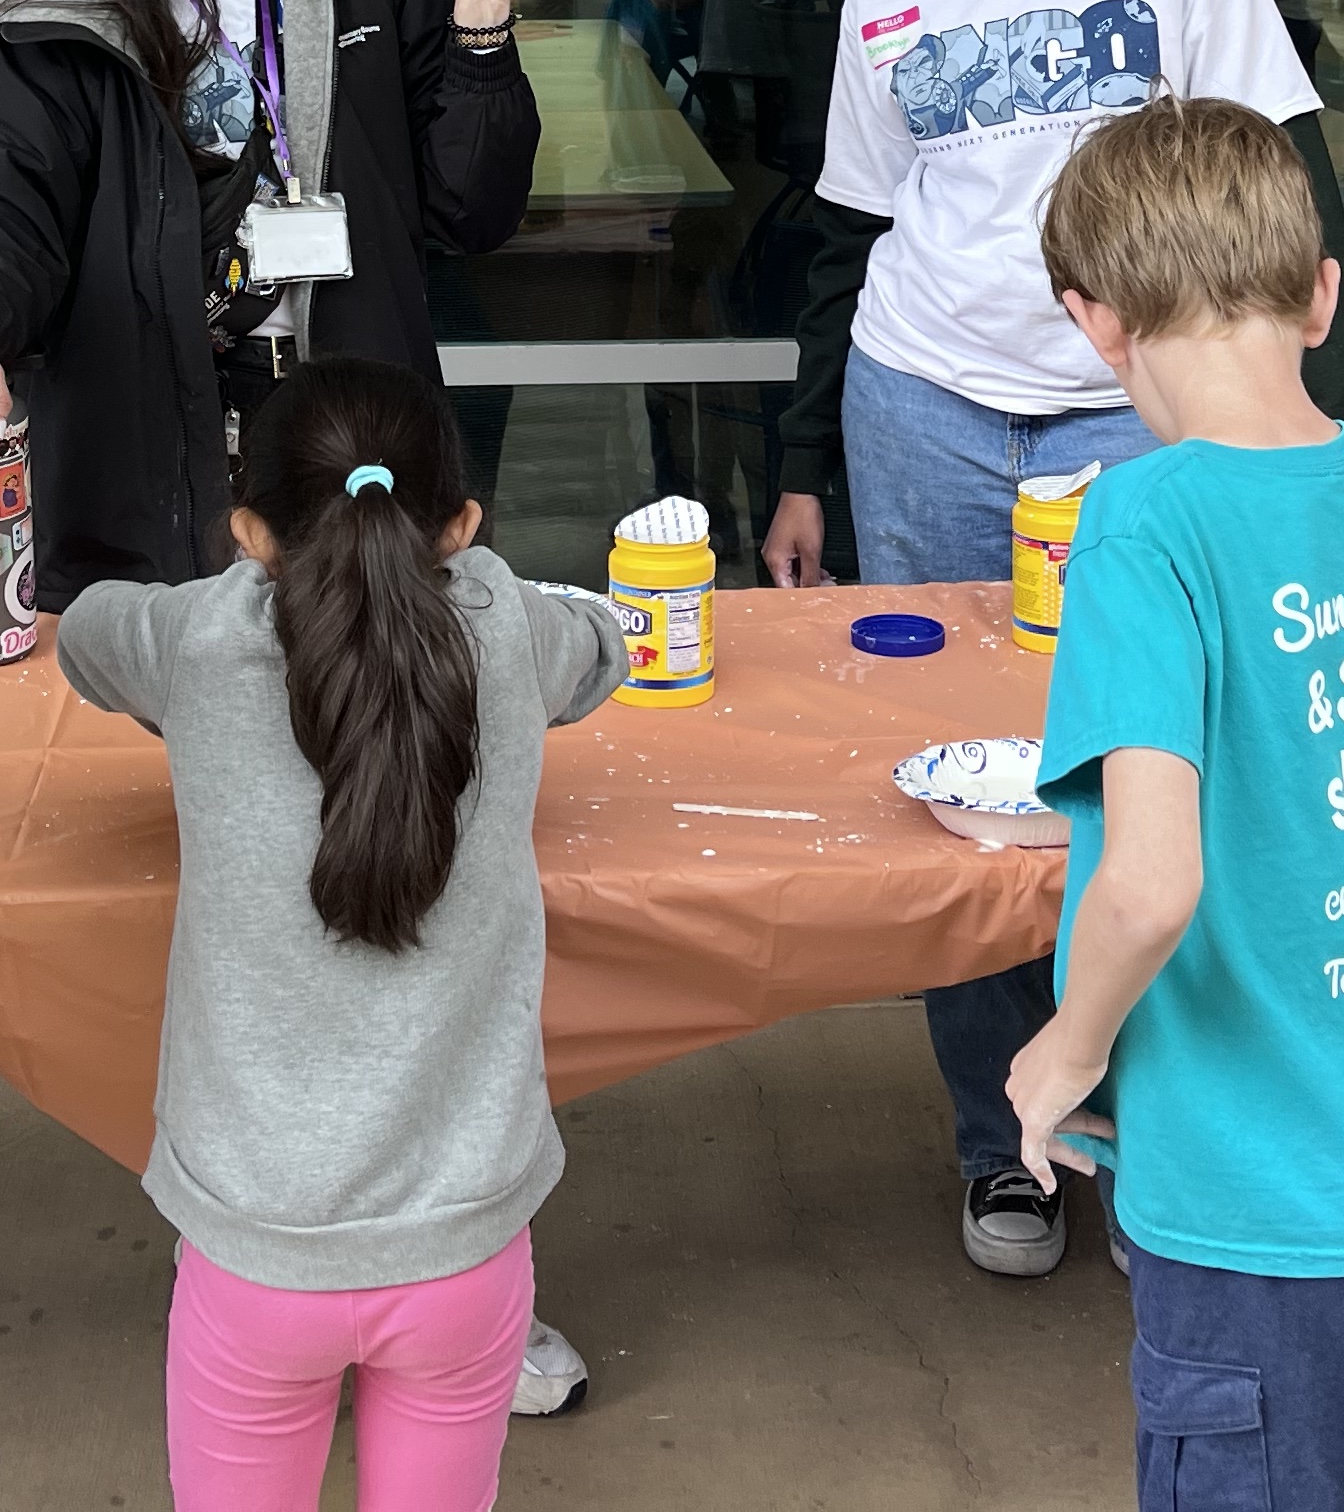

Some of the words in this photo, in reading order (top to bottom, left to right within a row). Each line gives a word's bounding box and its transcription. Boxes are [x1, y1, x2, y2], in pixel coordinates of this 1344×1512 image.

[876, 15, 905, 30] HELLO
[992, 119, 1082, 141] GENERATION
[1308, 669, 1334, 734] &
